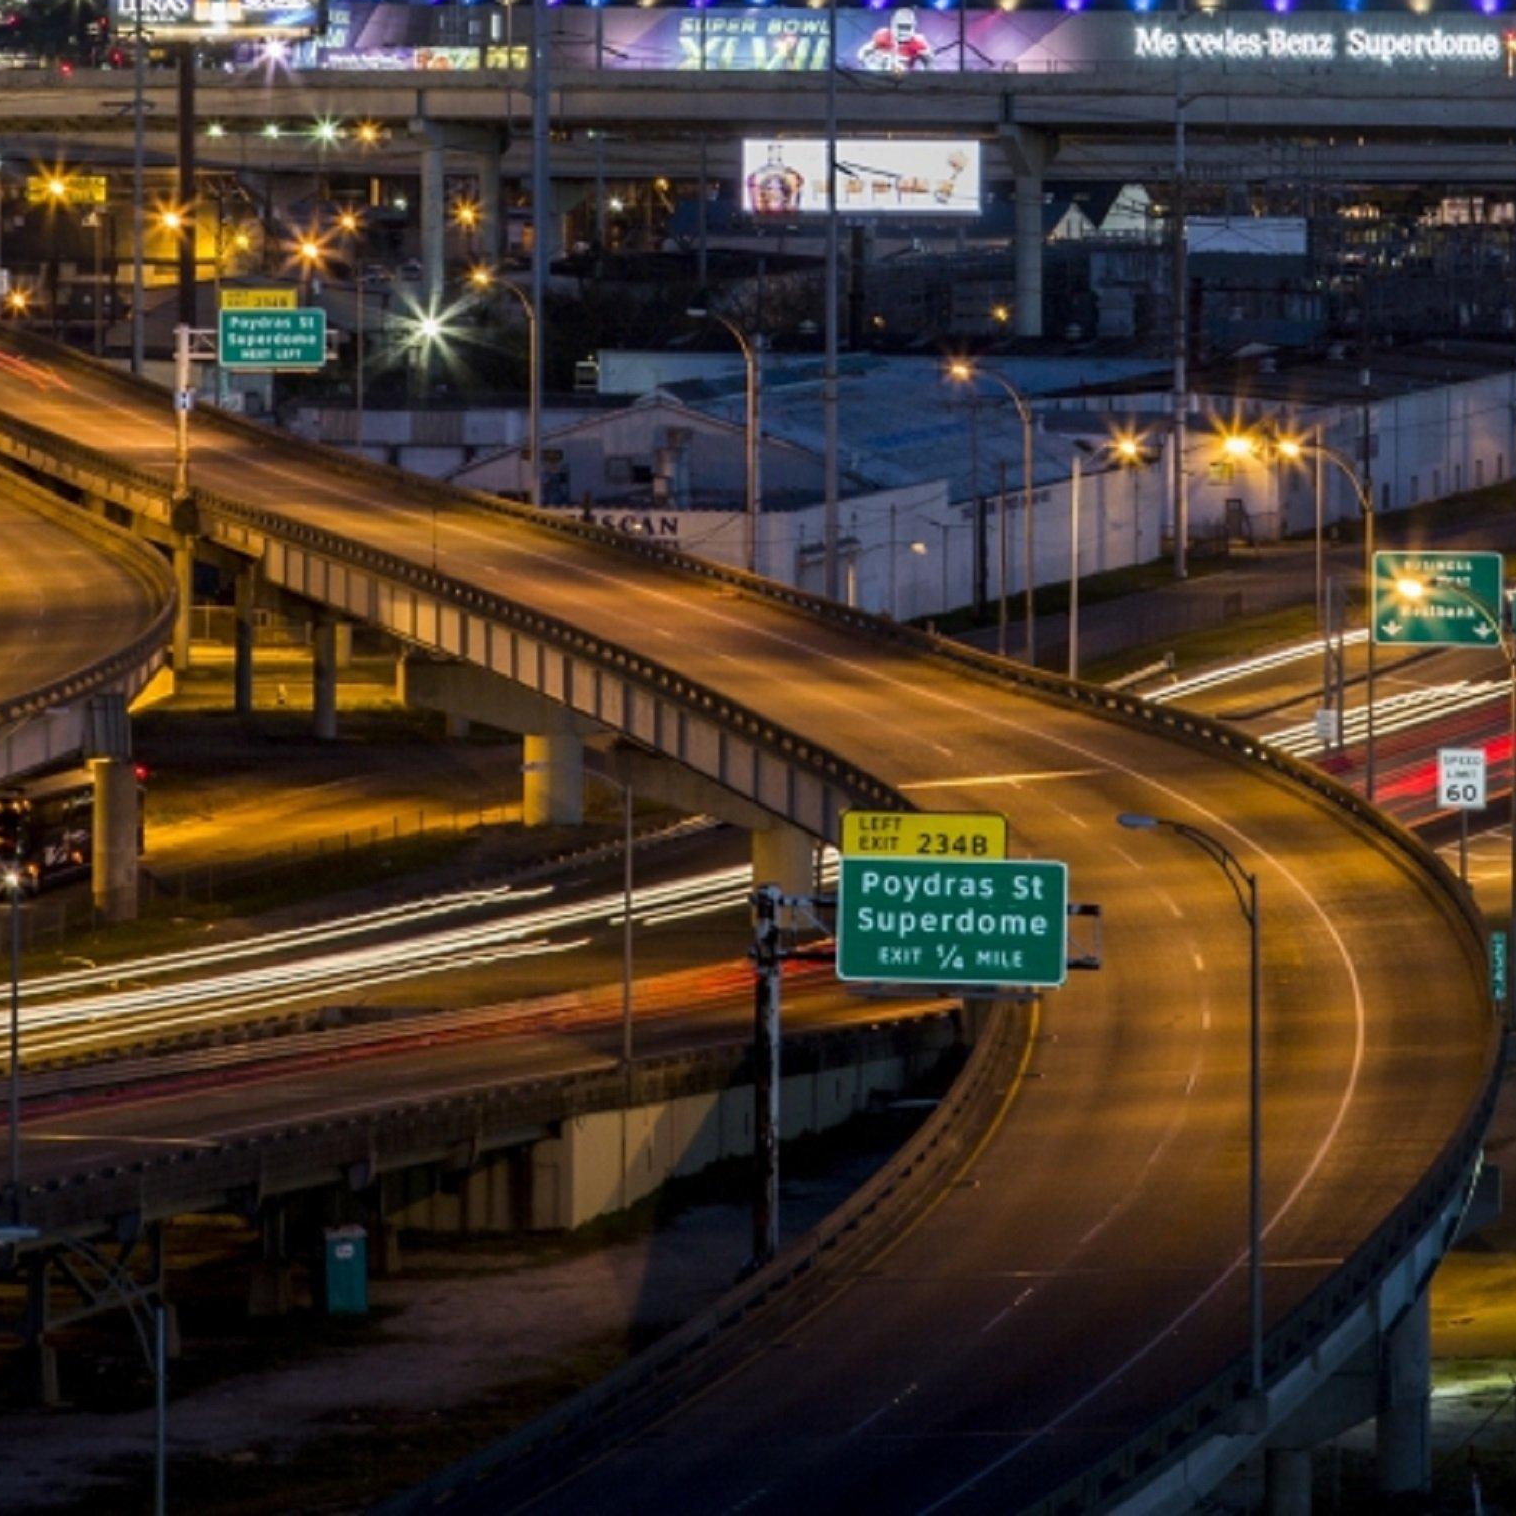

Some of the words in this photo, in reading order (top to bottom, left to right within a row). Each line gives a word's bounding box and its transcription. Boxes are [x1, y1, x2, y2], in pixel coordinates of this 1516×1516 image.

[679, 17, 758, 34] SUPER
[766, 18, 830, 35] BOWL
[1133, 26, 1334, 60] Mercedes-Benz
[1344, 27, 1501, 67] Superdome
[229, 315, 291, 331] Poydras
[298, 315, 315, 329] St
[227, 331, 317, 347] Superdome
[275, 348, 302, 359] LEFT
[1446, 783, 1477, 802] 60
[857, 816, 904, 832] LEFT
[857, 834, 901, 851] EXIT
[915, 833, 989, 856] 234B
[860, 870, 995, 903] Poydras
[1012, 874, 1045, 902] St
[856, 906, 1049, 940] Superdome
[877, 945, 923, 966] EXIT
[974, 950, 1026, 969] MILE
